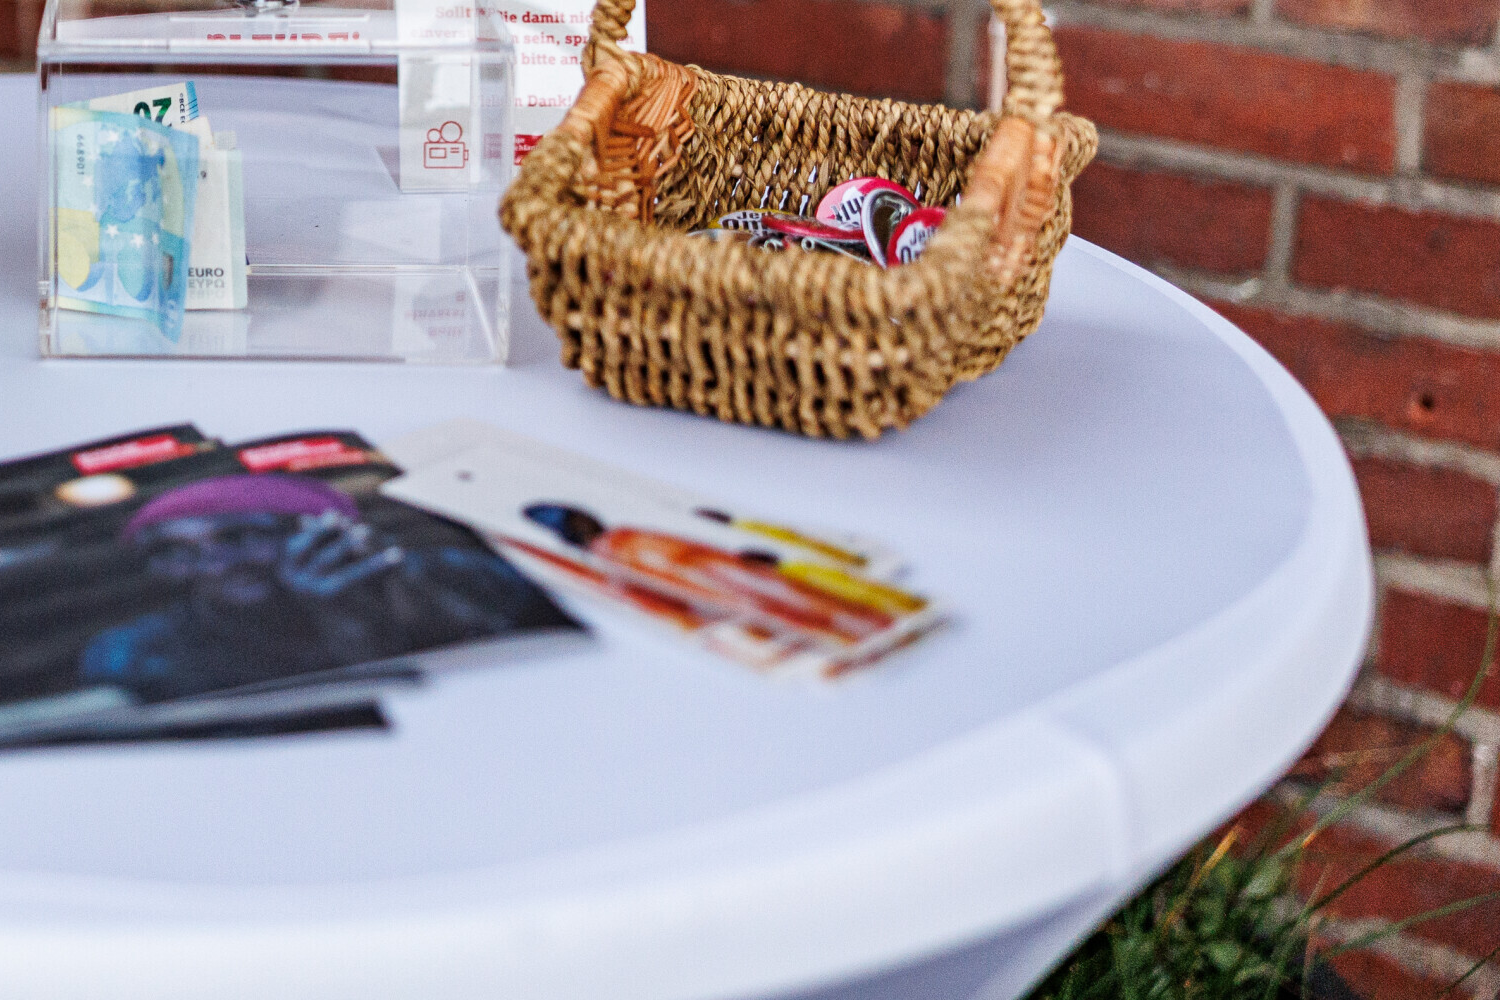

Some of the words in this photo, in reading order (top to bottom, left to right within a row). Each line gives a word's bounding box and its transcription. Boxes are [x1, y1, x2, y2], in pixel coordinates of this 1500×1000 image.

[521, 10, 565, 24] damit
[523, 32, 561, 47] sein,
[521, 52, 556, 65] bitte
[527, 95, 573, 107] Dank!
[187, 267, 225, 278] EURO
